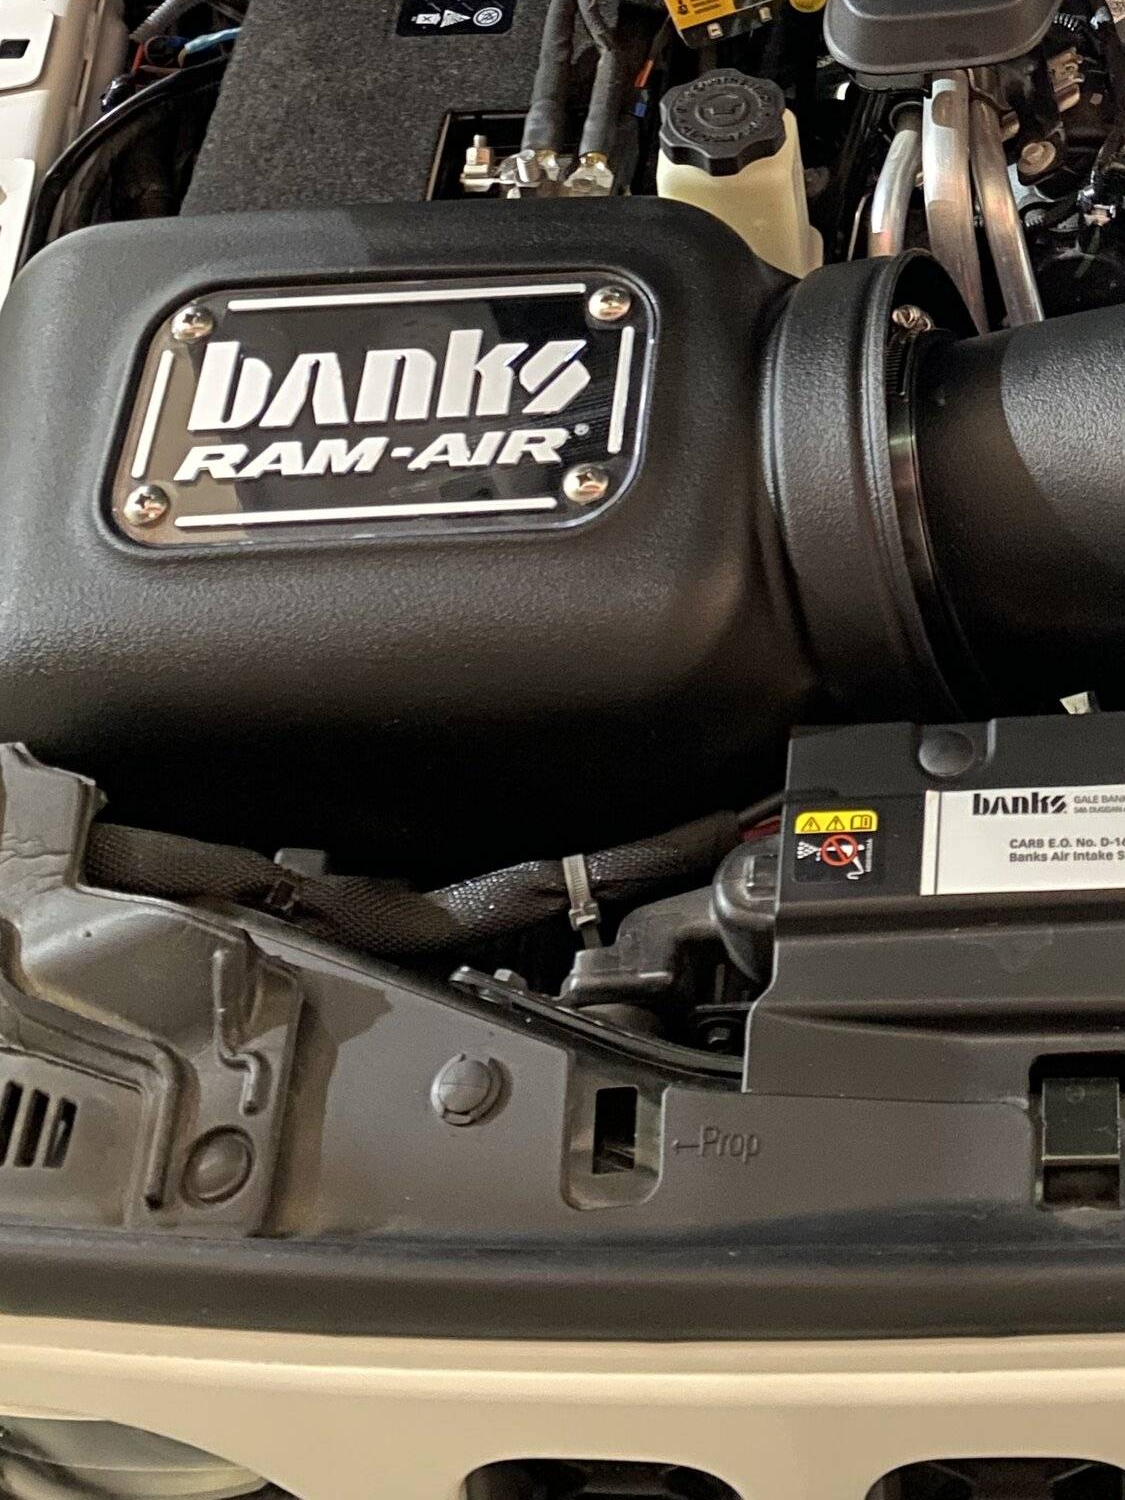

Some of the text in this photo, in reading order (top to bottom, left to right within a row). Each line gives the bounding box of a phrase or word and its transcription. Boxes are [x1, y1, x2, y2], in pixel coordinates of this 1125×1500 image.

[1073, 794, 1100, 804] GALE
[1009, 838, 1044, 849] CARB
[1048, 837, 1072, 848] E.O.
[1075, 837, 1097, 848] No.
[1009, 852, 1048, 863] Banks
[1050, 851, 1070, 861] Air
[1073, 850, 1114, 861] Intake
[699, 1125, 761, 1164] Prop
